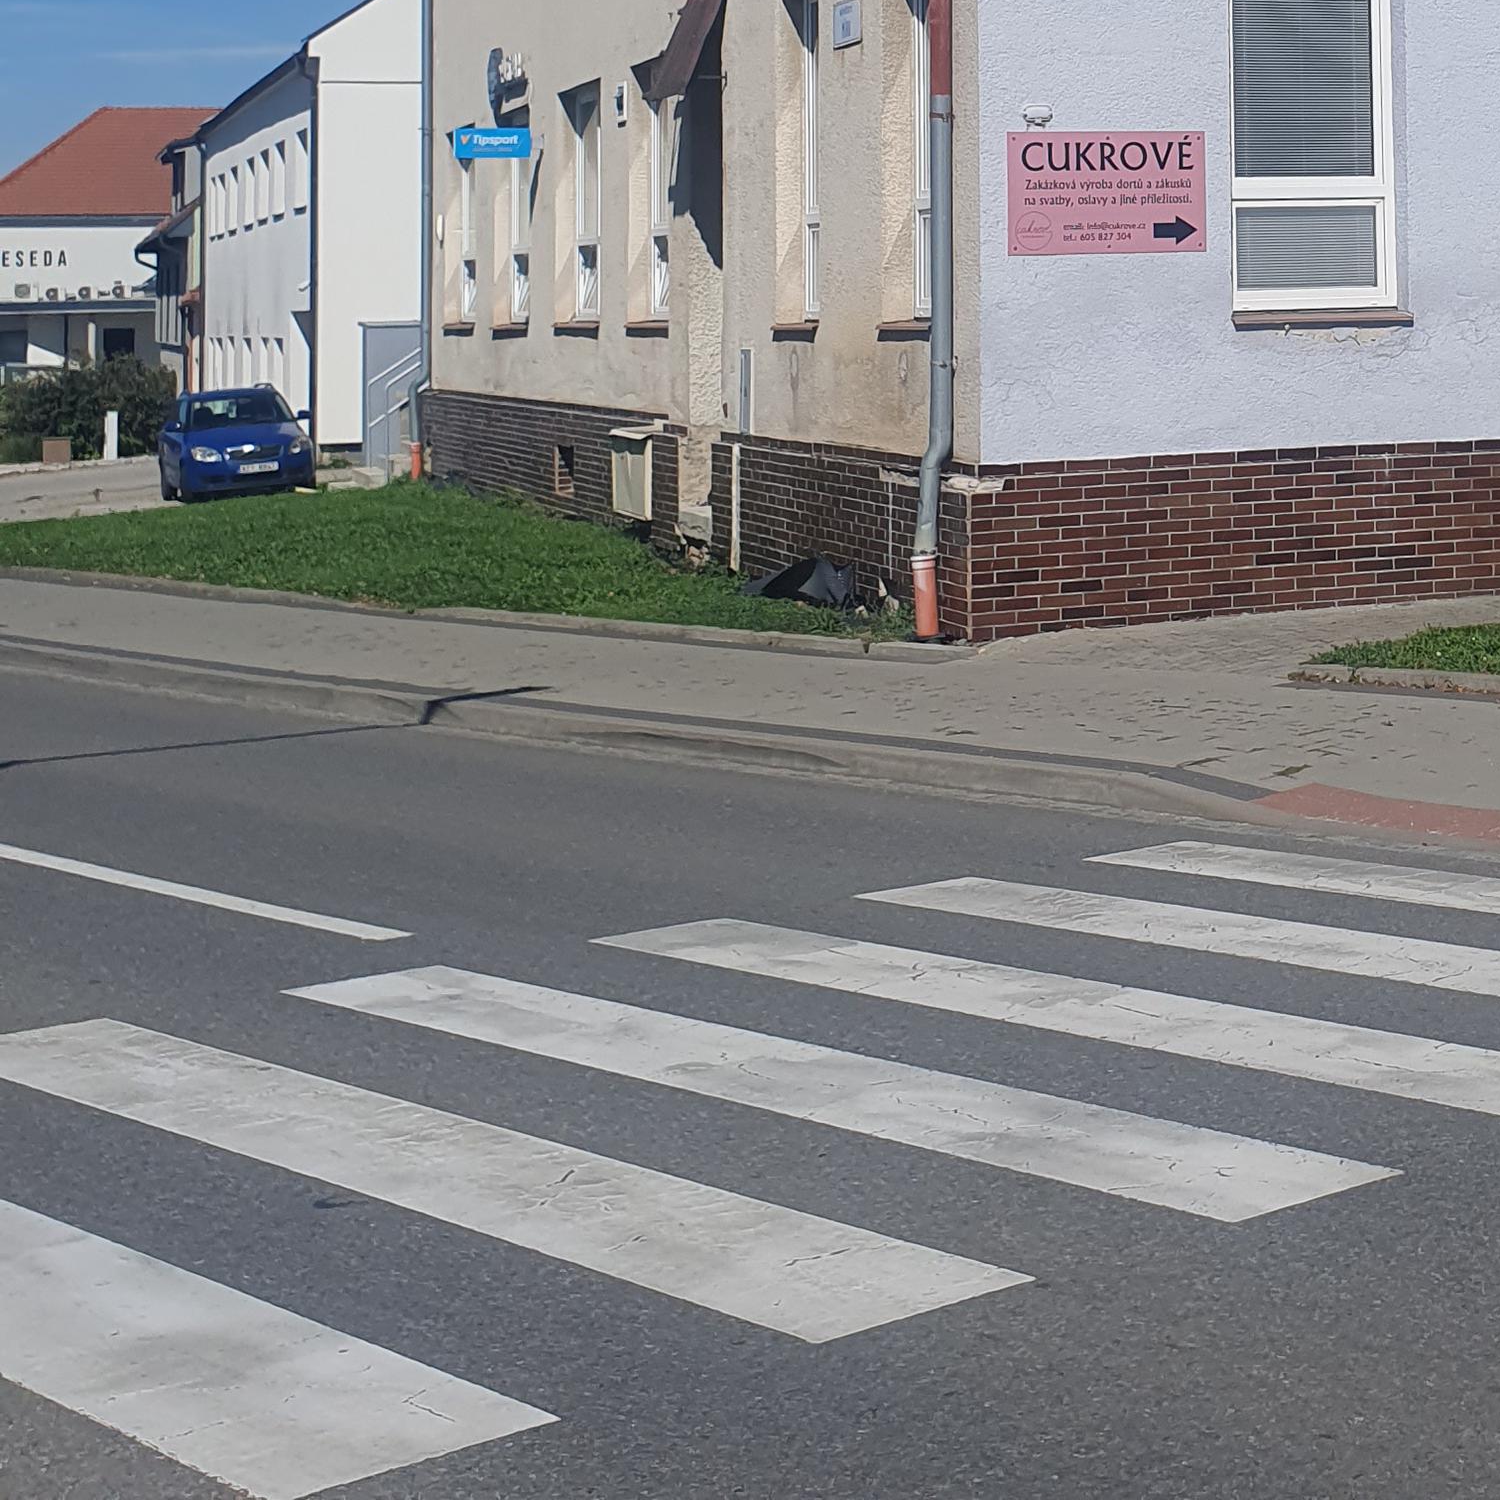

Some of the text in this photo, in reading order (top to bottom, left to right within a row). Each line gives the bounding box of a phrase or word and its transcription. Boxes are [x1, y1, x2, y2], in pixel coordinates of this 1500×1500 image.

[1020, 135, 1195, 172] CUKROVÉ
[1025, 177, 1192, 191] Zakázková výroba dortů a zákusků
[1024, 193, 1193, 207] na svatby, oslavy a jiné příležitosti.
[1080, 233, 1095, 241] 605
[1098, 232, 1113, 241] 827
[1116, 232, 1132, 241] 304
